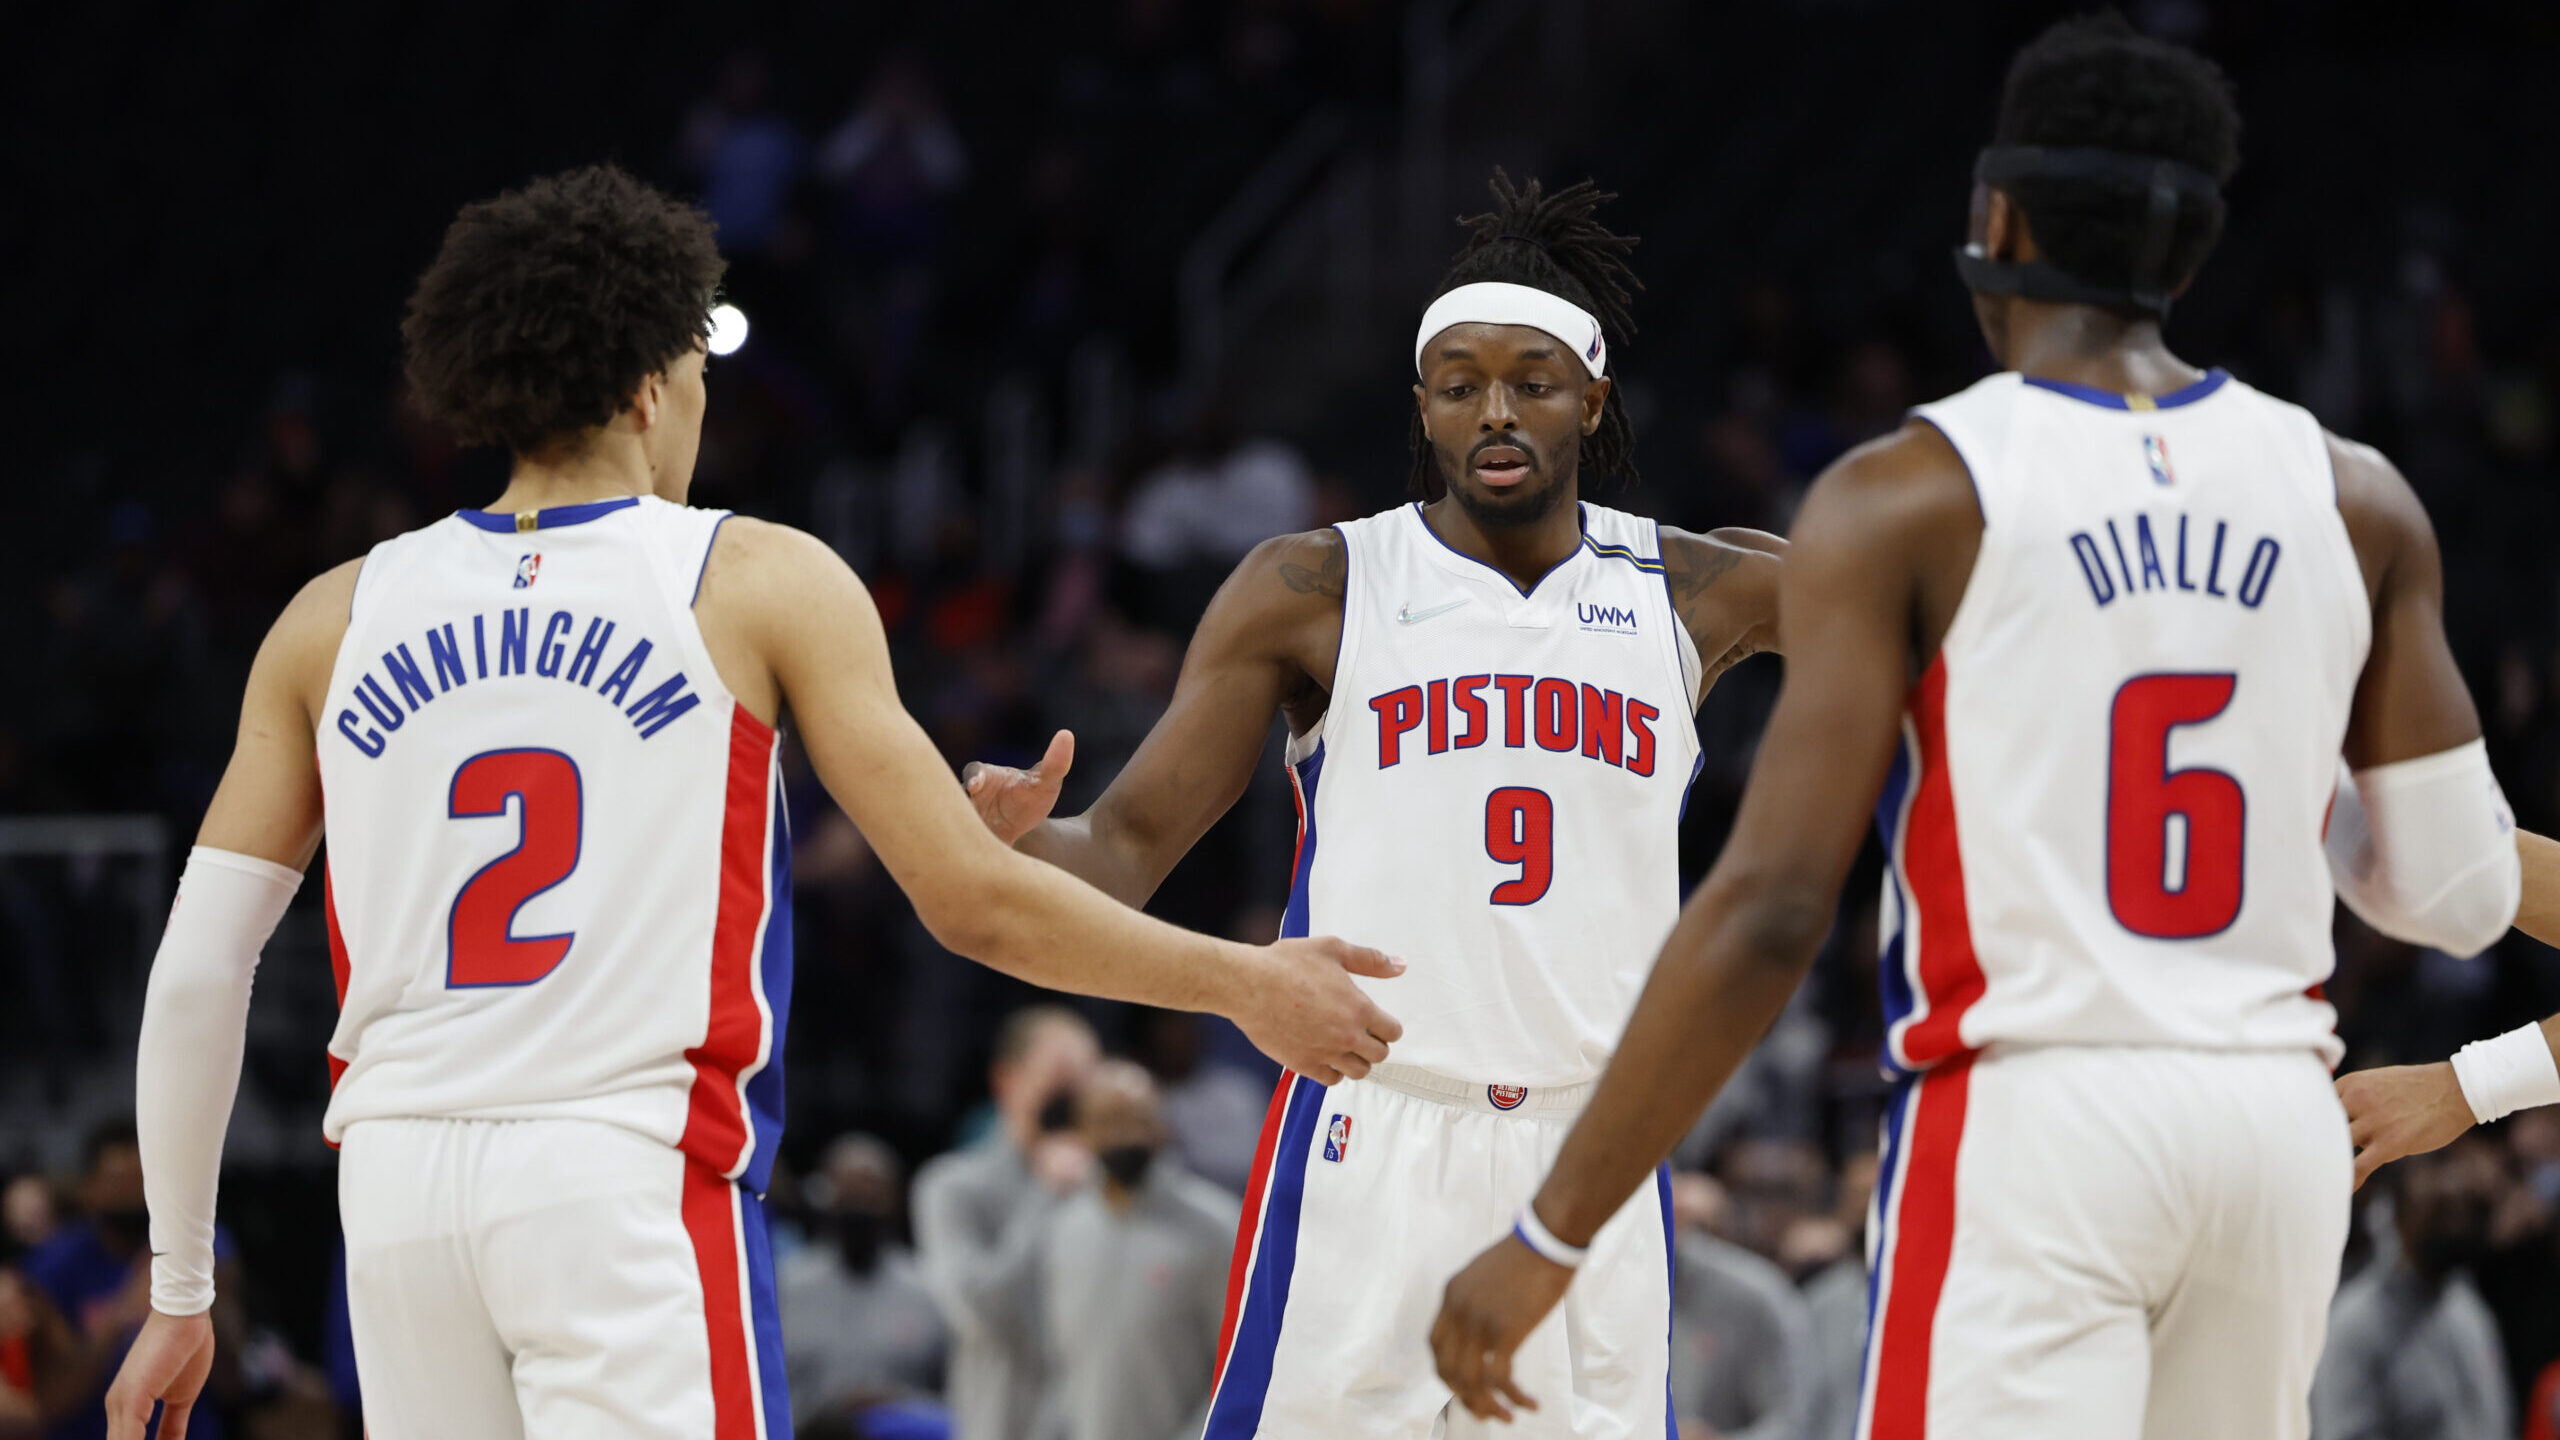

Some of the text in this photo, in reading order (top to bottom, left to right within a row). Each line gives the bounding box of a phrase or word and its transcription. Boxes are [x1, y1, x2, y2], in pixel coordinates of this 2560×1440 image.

[1578, 602, 1637, 628] UWM
[2069, 513, 2281, 611] DIALLO
[337, 607, 701, 760] CUNNINGHAM
[1368, 673, 1660, 778] PISTONS
[1485, 786, 1554, 906] 9
[2105, 669, 2245, 940] 6
[445, 747, 583, 990] 2
